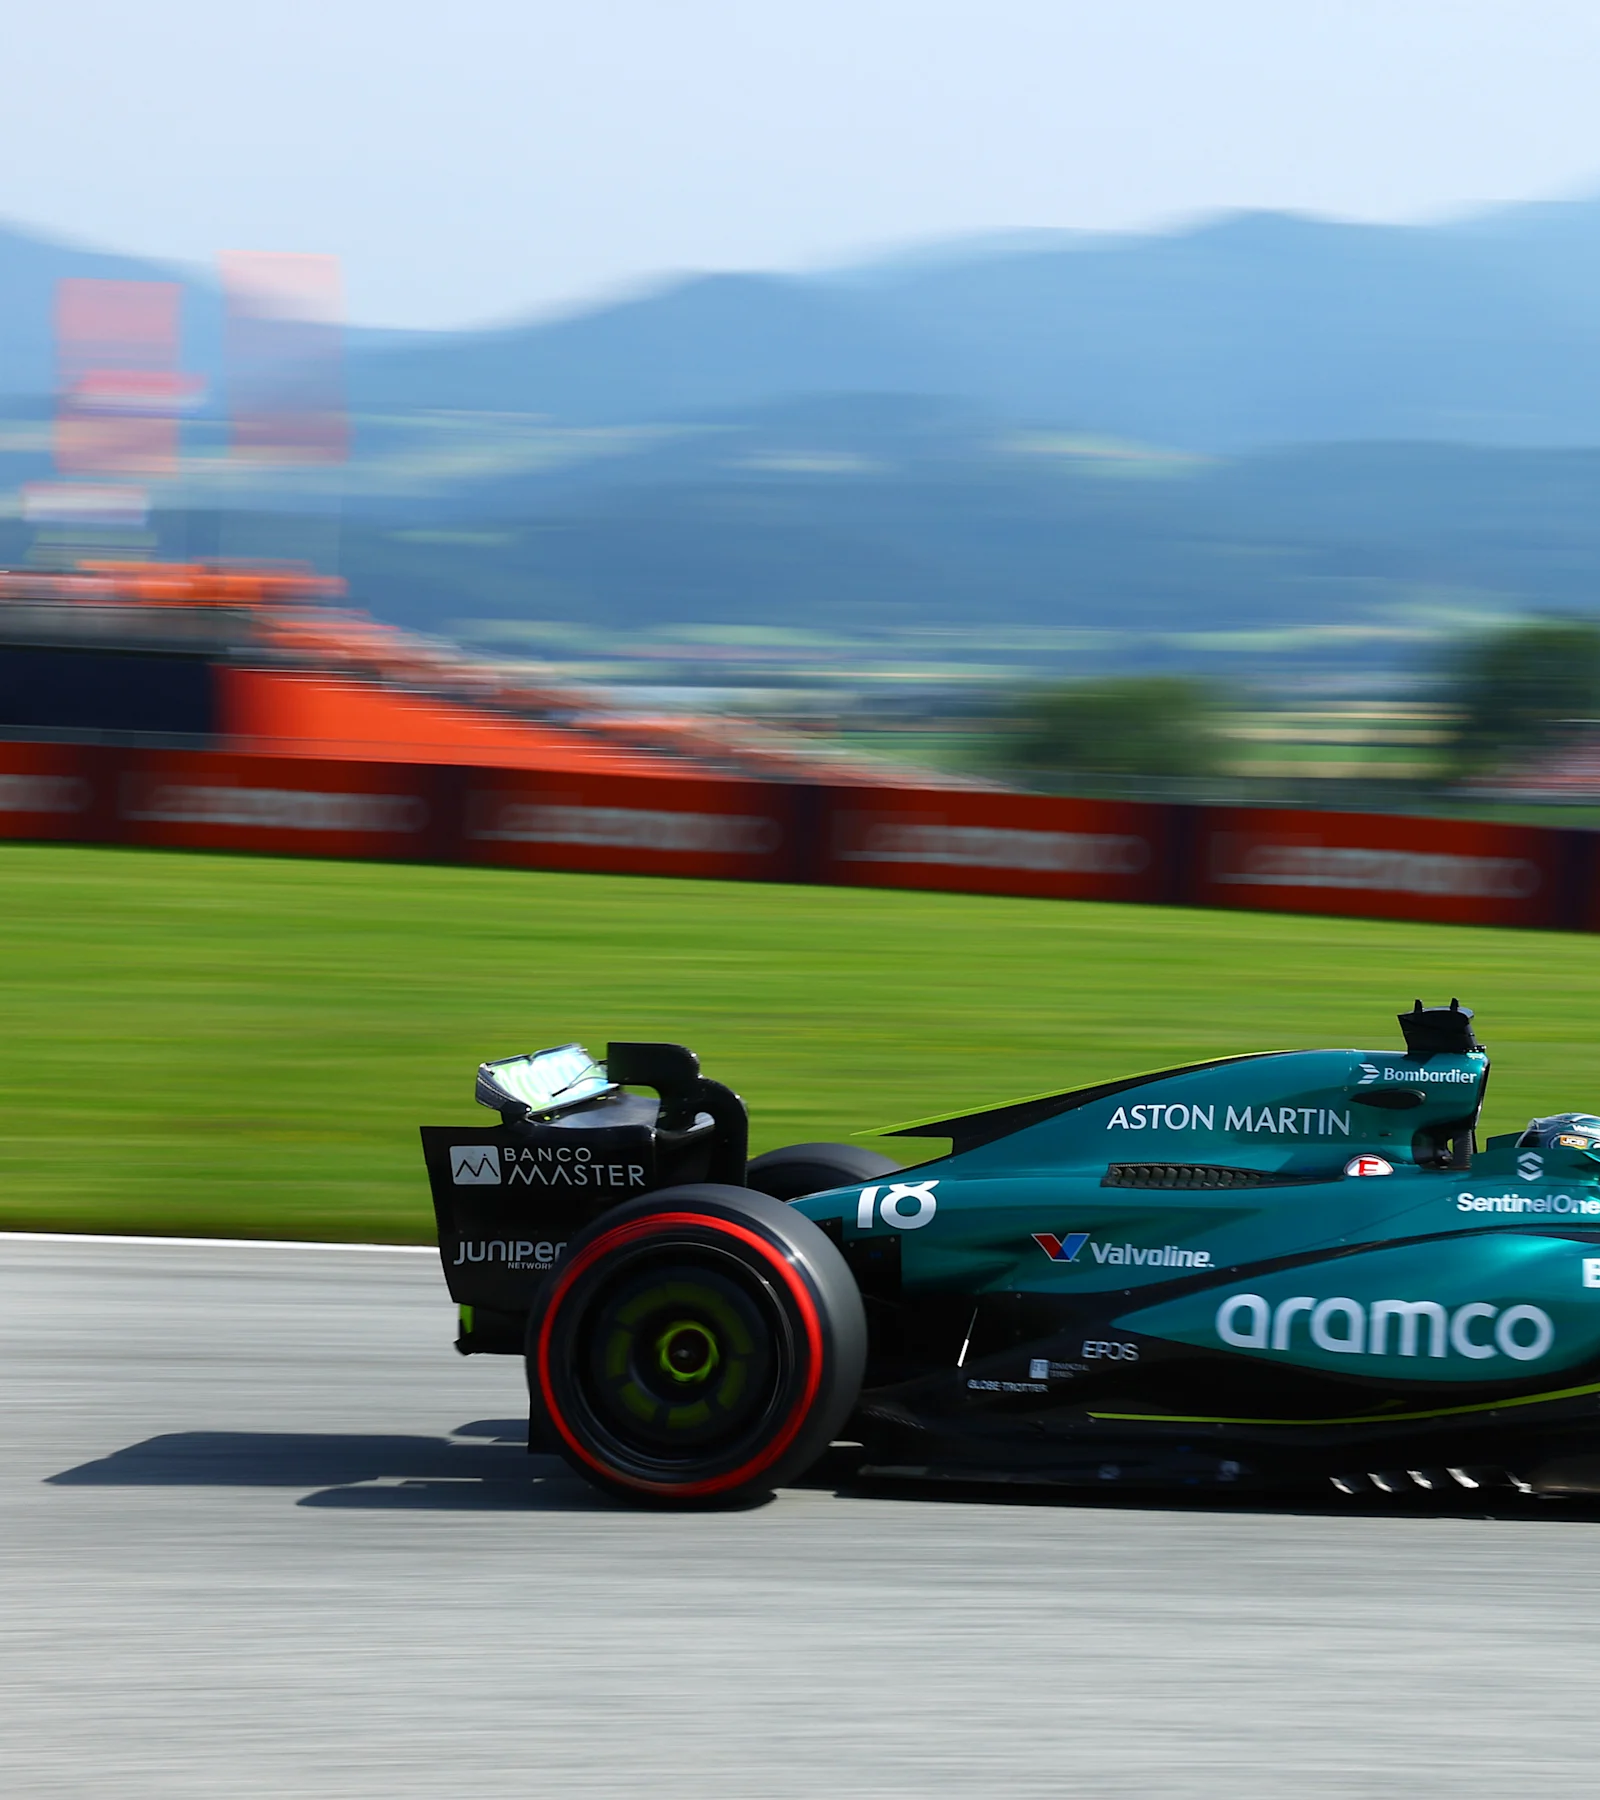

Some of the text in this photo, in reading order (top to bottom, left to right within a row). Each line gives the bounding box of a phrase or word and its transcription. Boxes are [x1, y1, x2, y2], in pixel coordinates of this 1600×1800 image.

[1384, 1067, 1477, 1083] Bombardier
[1107, 1104, 1351, 1136] ASTON MARTIN
[503, 1147, 592, 1162] BANCO
[508, 1164, 646, 1187] MASTER
[1358, 1160, 1379, 1176] E
[857, 1180, 940, 1230] 18
[1090, 1242, 1211, 1267] Valvoline
[1215, 1293, 1555, 1361] aramco
[1082, 1340, 1139, 1361] EPOS
